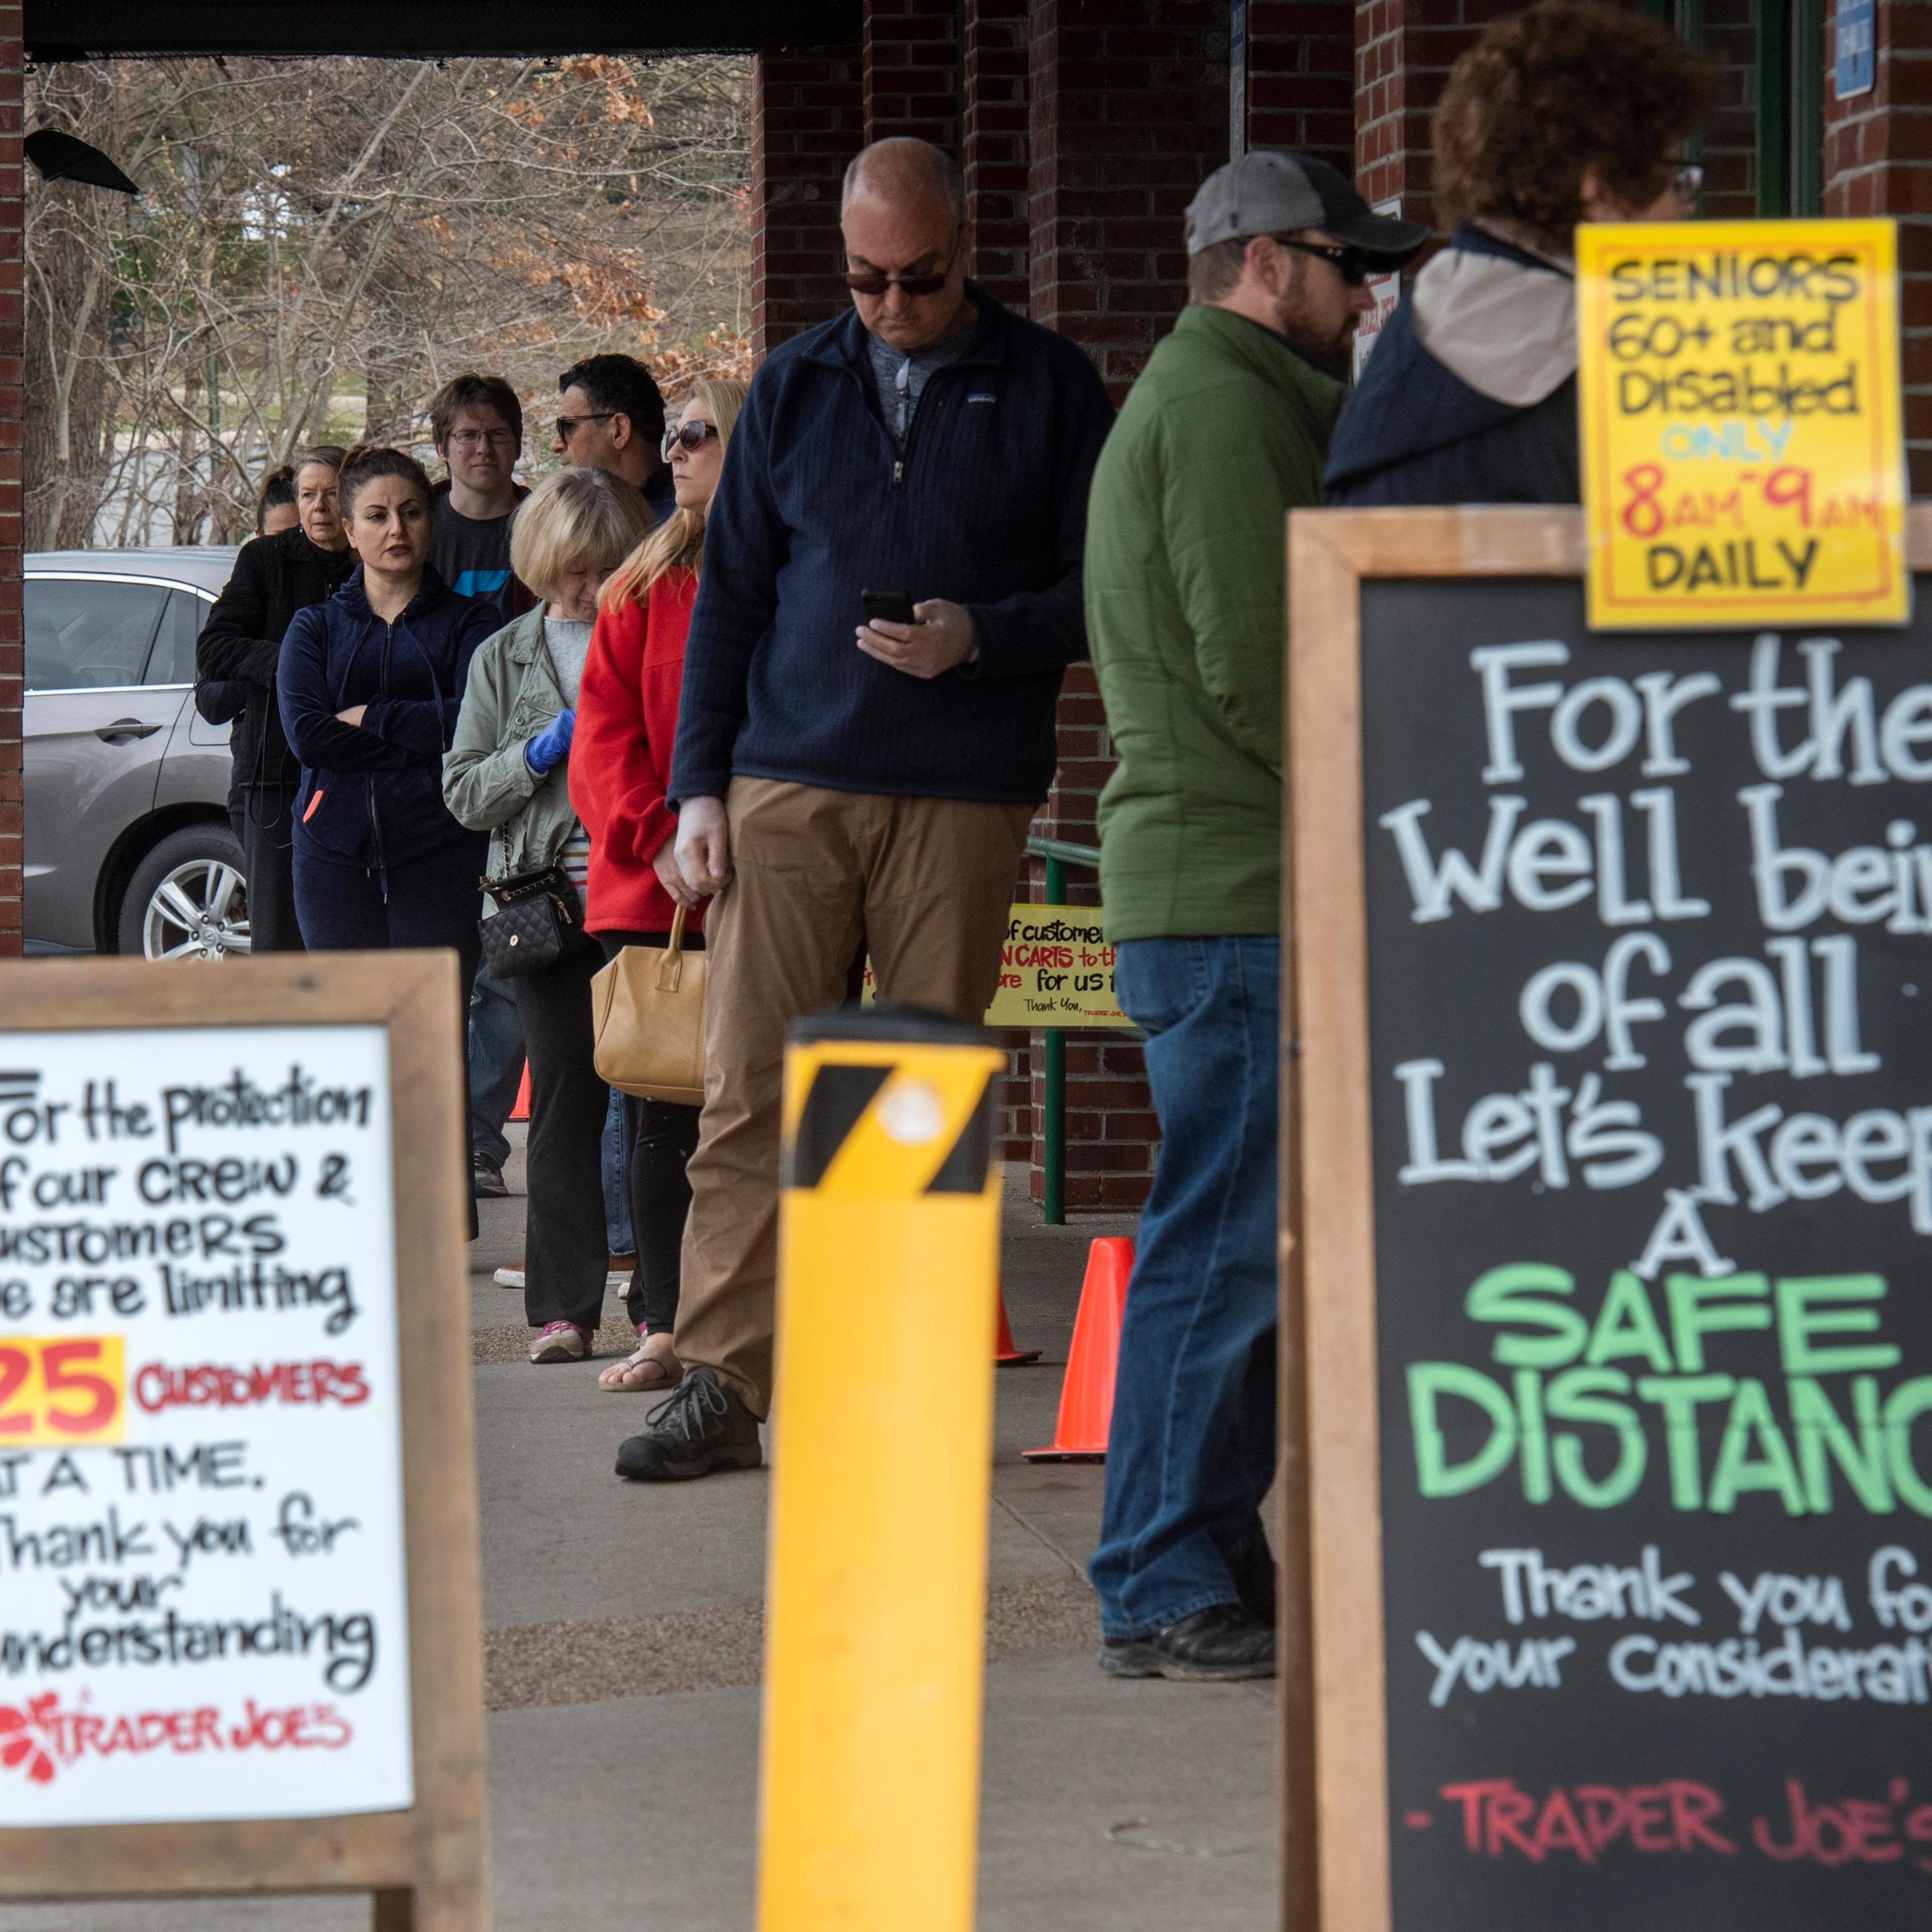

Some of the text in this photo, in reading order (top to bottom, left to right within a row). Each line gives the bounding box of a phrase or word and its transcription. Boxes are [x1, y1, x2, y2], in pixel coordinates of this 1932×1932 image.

[1611, 255, 1862, 303] SENIORS
[1609, 304, 1838, 361] 60+ and
[1659, 420, 1795, 462] ONLY
[1646, 537, 1820, 592] DAILY
[1470, 634, 1932, 785] For the
[1379, 786, 1711, 926] Well
[1015, 944, 1074, 969] CARTS
[1078, 946, 1098, 968] to
[1037, 969, 1069, 992] for
[1074, 973, 1103, 992] us
[1023, 997, 1057, 1012] Thank
[1518, 931, 1882, 1078] of all
[80, 1078, 155, 1141] the
[160, 1063, 371, 1155] protection
[1394, 1058, 1664, 1189] Let's
[33, 1166, 117, 1208] our
[1629, 1187, 1736, 1280] A
[49, 1276, 146, 1318] are
[156, 1262, 360, 1336] limiting
[1465, 1261, 1902, 1376] SAFE
[0, 1340, 370, 1435] 25 CUSTOMERS
[42, 1449, 90, 1496] A
[1407, 1361, 1932, 1519] DISTANC
[162, 1514, 253, 1570] you
[271, 1491, 362, 1558] for
[59, 1573, 184, 1621] your
[1479, 1544, 1932, 1634] Thank you fo
[1415, 1629, 1578, 1709] your
[49, 1707, 224, 1761] TRADER
[1439, 1776, 1738, 1865] TRADER
